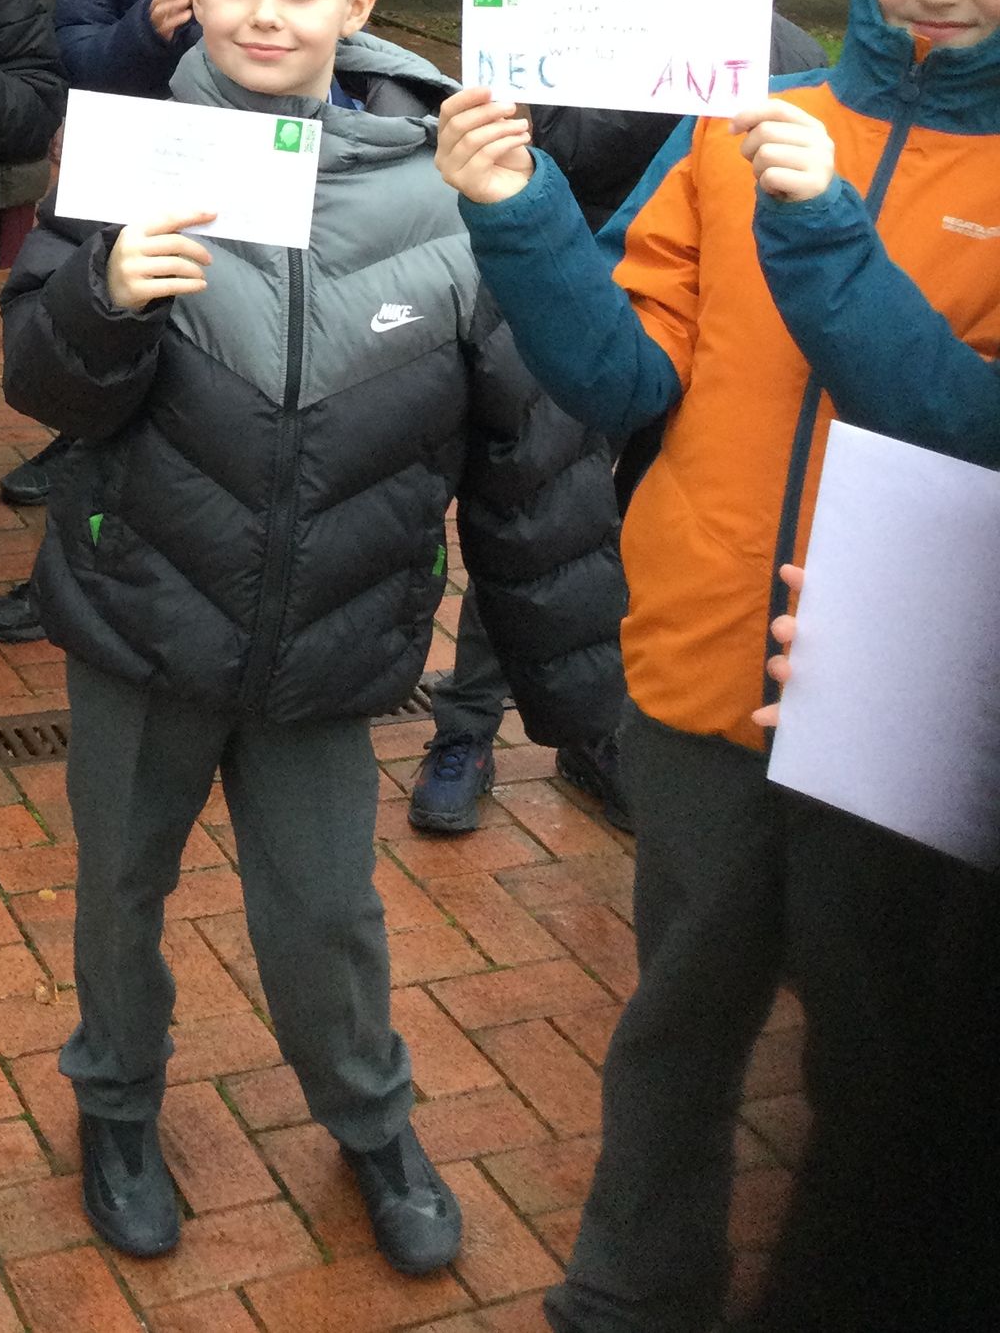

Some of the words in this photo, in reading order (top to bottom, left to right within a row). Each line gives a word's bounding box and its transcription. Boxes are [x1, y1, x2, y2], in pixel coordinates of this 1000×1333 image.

[477, 50, 556, 90] DEC
[651, 55, 750, 104] ANT
[378, 302, 412, 321] NIKE
